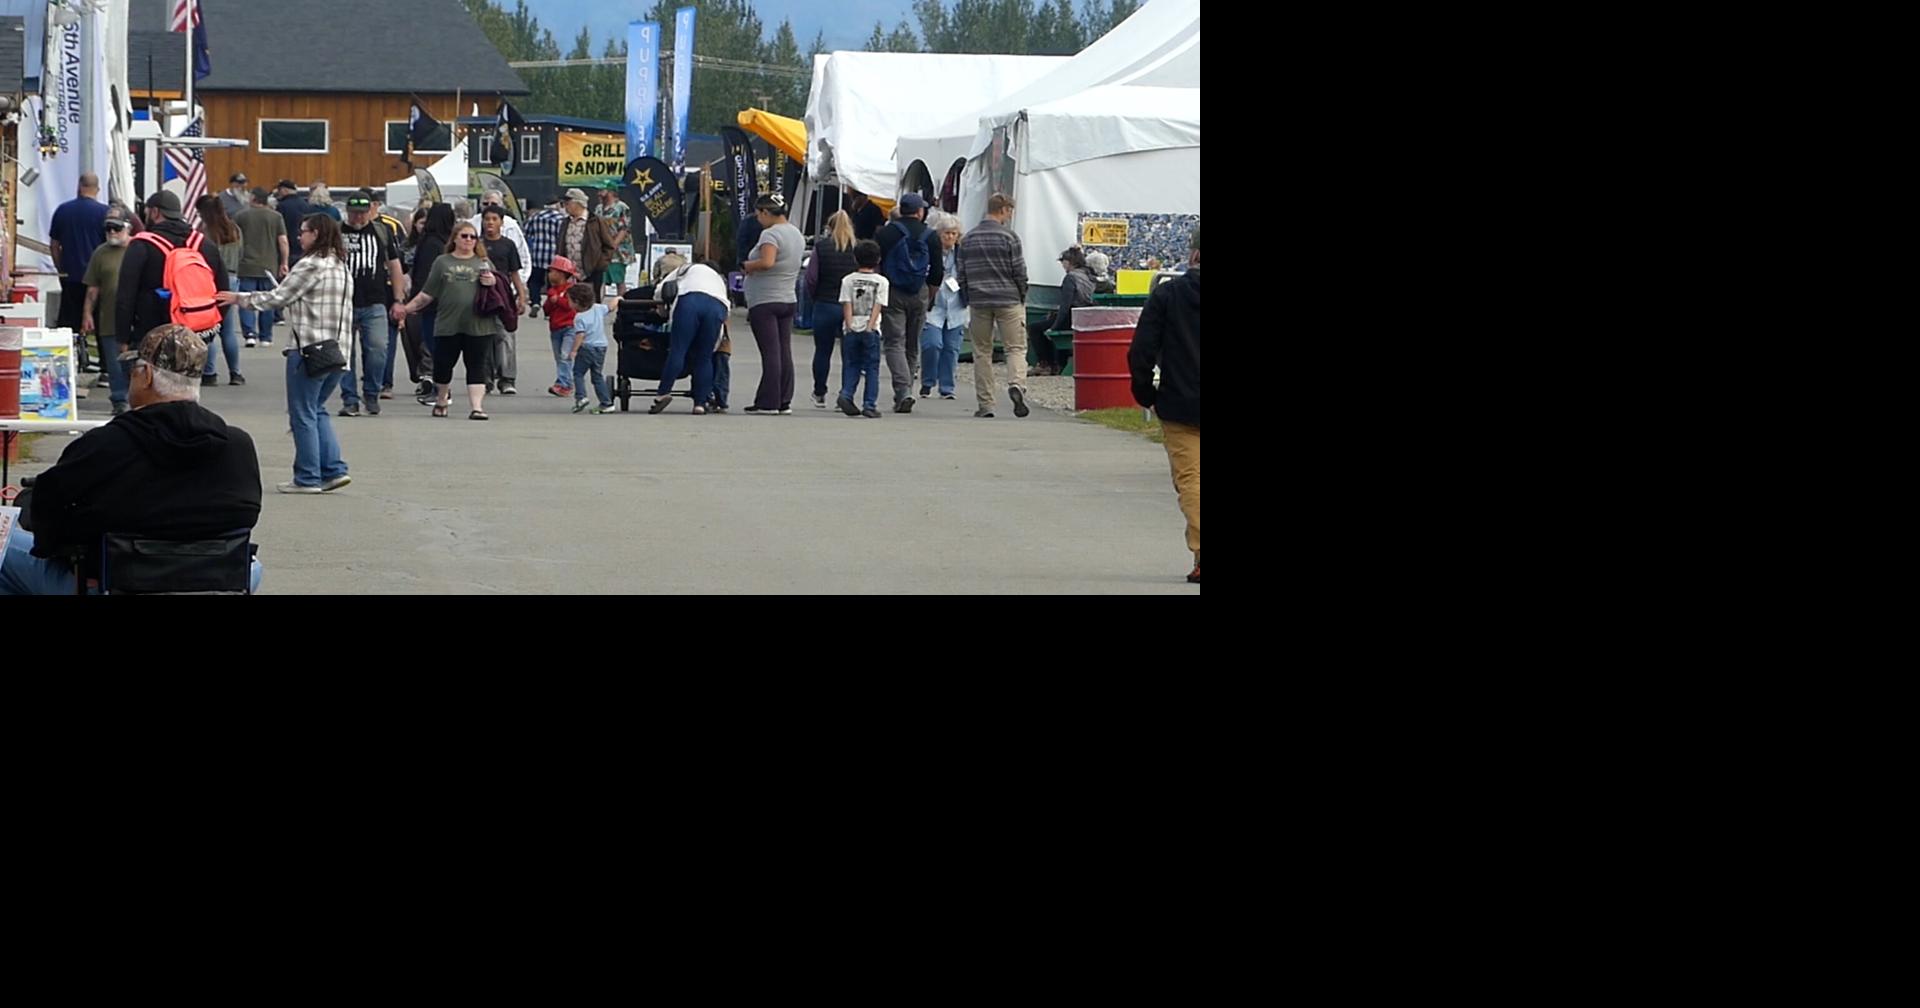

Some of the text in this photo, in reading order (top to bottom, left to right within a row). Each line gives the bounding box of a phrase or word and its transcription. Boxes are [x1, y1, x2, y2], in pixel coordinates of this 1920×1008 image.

[64, 51, 80, 124] Avenue
[58, 116, 69, 154] CO-OP
[582, 143, 625, 157] GRILL
[564, 161, 626, 175] SANDWI
[735, 154, 745, 188] GUARD
